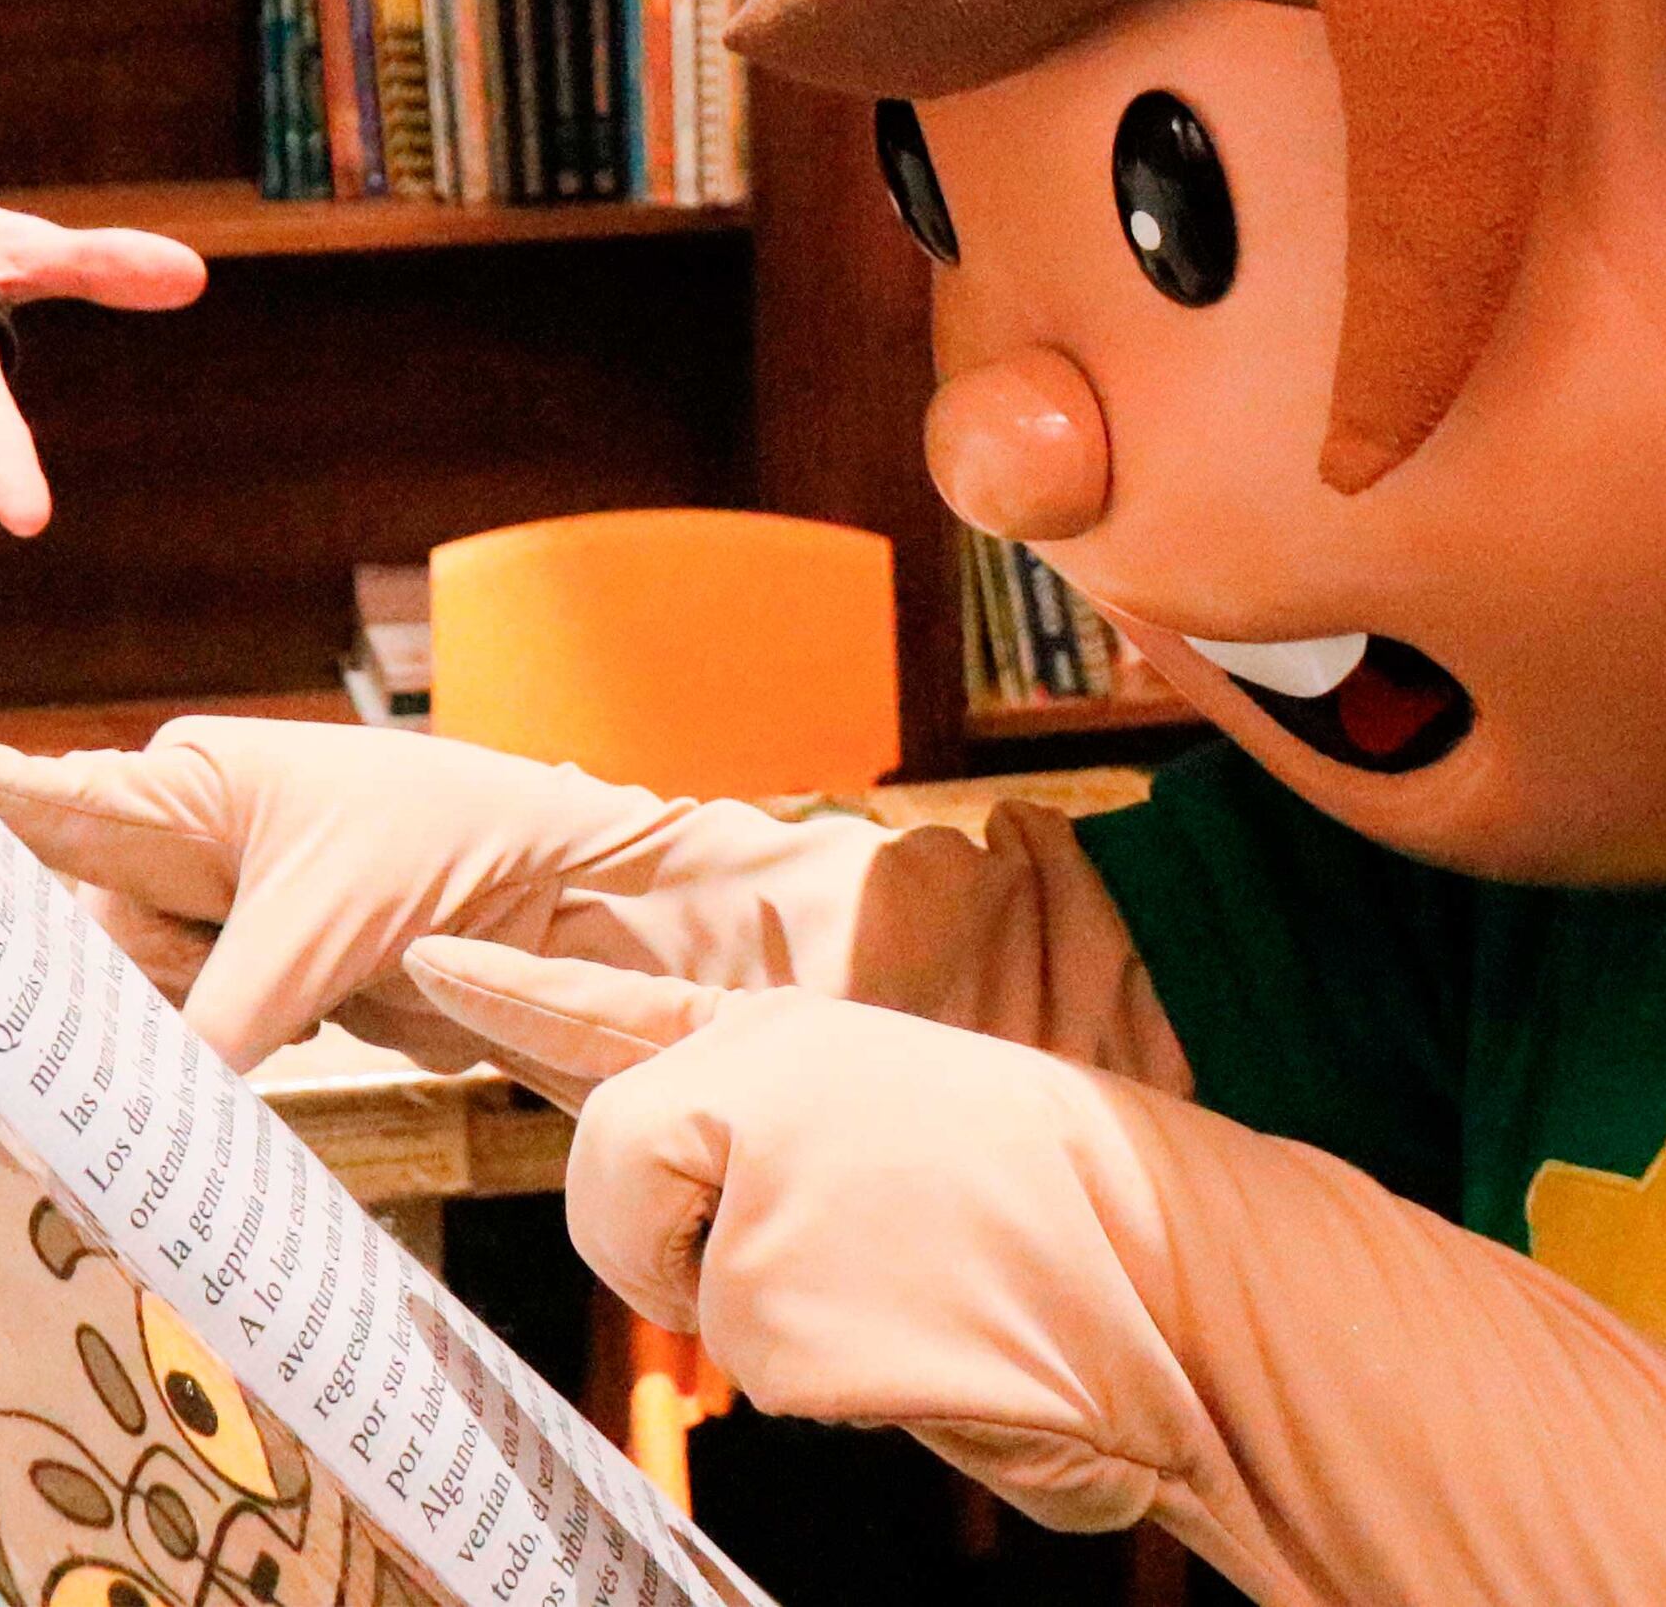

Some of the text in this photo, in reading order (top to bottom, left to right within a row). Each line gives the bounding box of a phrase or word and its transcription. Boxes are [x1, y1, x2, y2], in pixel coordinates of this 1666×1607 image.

[31, 948, 49, 978] no
[28, 1004, 78, 1097] mientras
[58, 1092, 98, 1136] las
[83, 1137, 132, 1193] Los
[121, 1094, 153, 1136] días
[129, 1108, 192, 1230] ordenaban
[157, 1238, 192, 1271] la
[187, 1166, 225, 1243] gente
[201, 1194, 264, 1306] deprimía
[238, 1314, 266, 1347] A
[252, 1281, 283, 1314] lo
[268, 1226, 302, 1280] lejos
[276, 1266, 336, 1383] aventuras
[324, 1223, 342, 1262] con
[311, 1287, 375, 1420] regresaban
[348, 1398, 387, 1464] por
[381, 1357, 406, 1399] sus
[384, 1435, 423, 1502] por
[409, 1363, 446, 1437] haber
[419, 1418, 478, 1534] Algunos
[461, 1387, 484, 1418] de
[456, 1471, 511, 1563] venían
[499, 1425, 520, 1470] con
[490, 1532, 541, 1602] todo,
[526, 1487, 550, 1522] él
